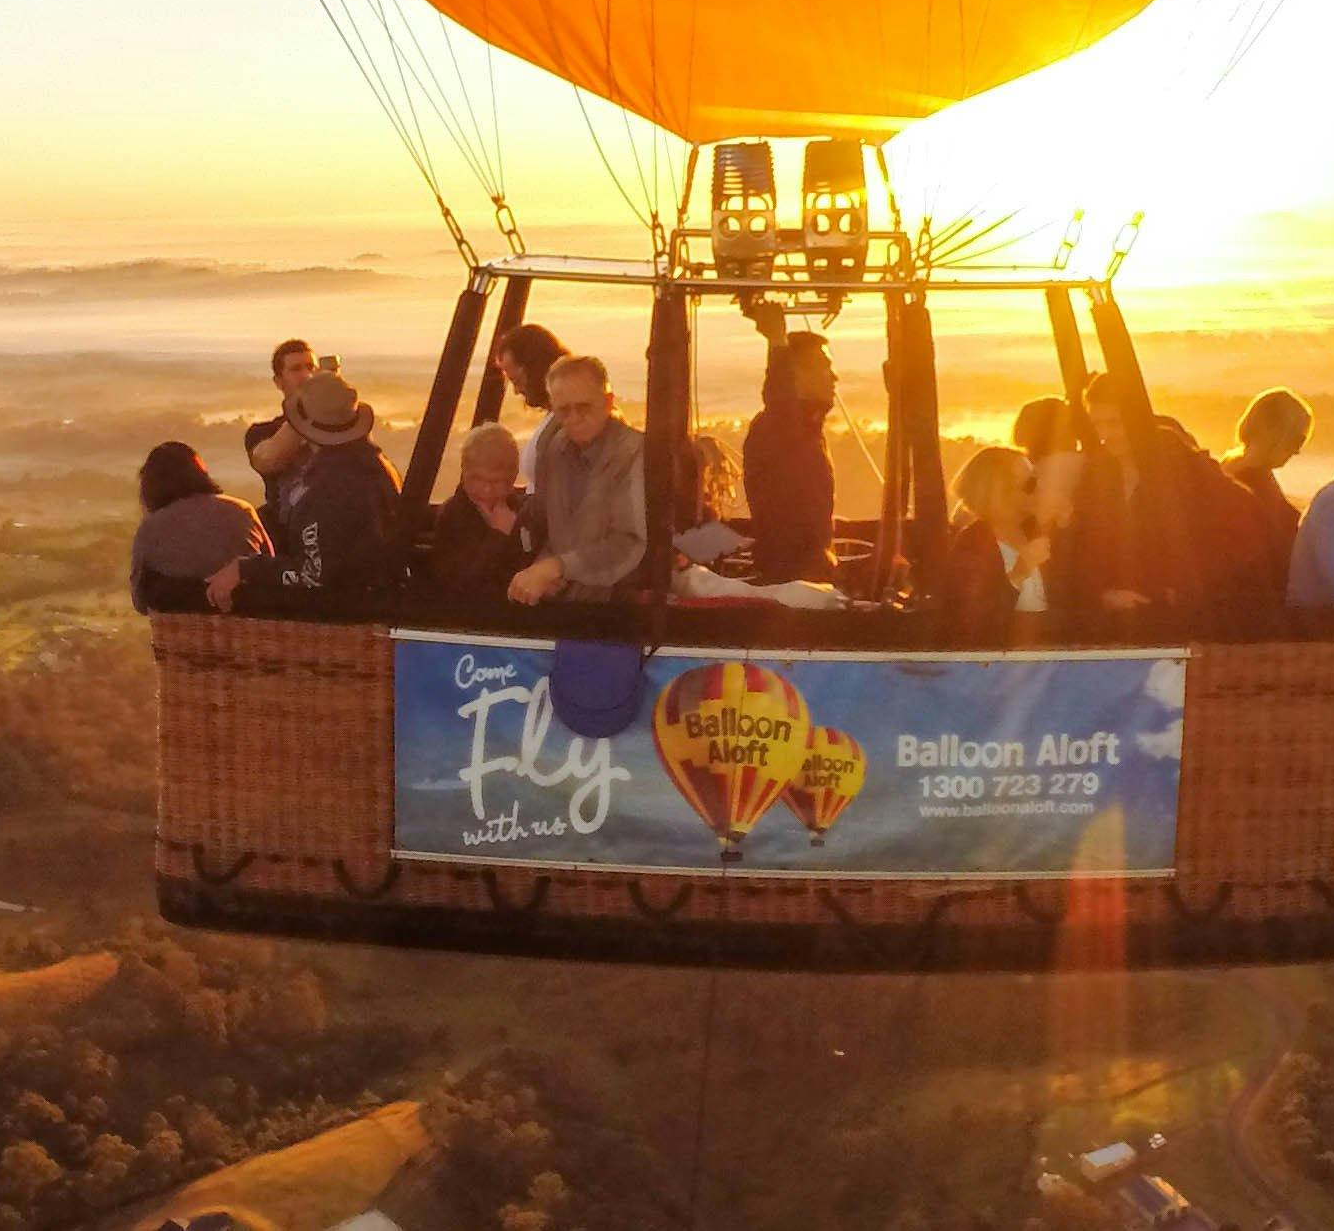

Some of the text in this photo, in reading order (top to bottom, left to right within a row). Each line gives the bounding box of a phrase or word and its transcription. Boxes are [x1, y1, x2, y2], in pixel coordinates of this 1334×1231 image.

[455, 654, 517, 689] Come
[685, 708, 792, 742] Balloon
[457, 676, 632, 835] Fly
[708, 739, 770, 766] Aloft
[801, 754, 855, 773] alloon
[897, 731, 1121, 768] Balloon Aloft
[918, 772, 1100, 798] 1300 723 279
[463, 801, 568, 846] with us
